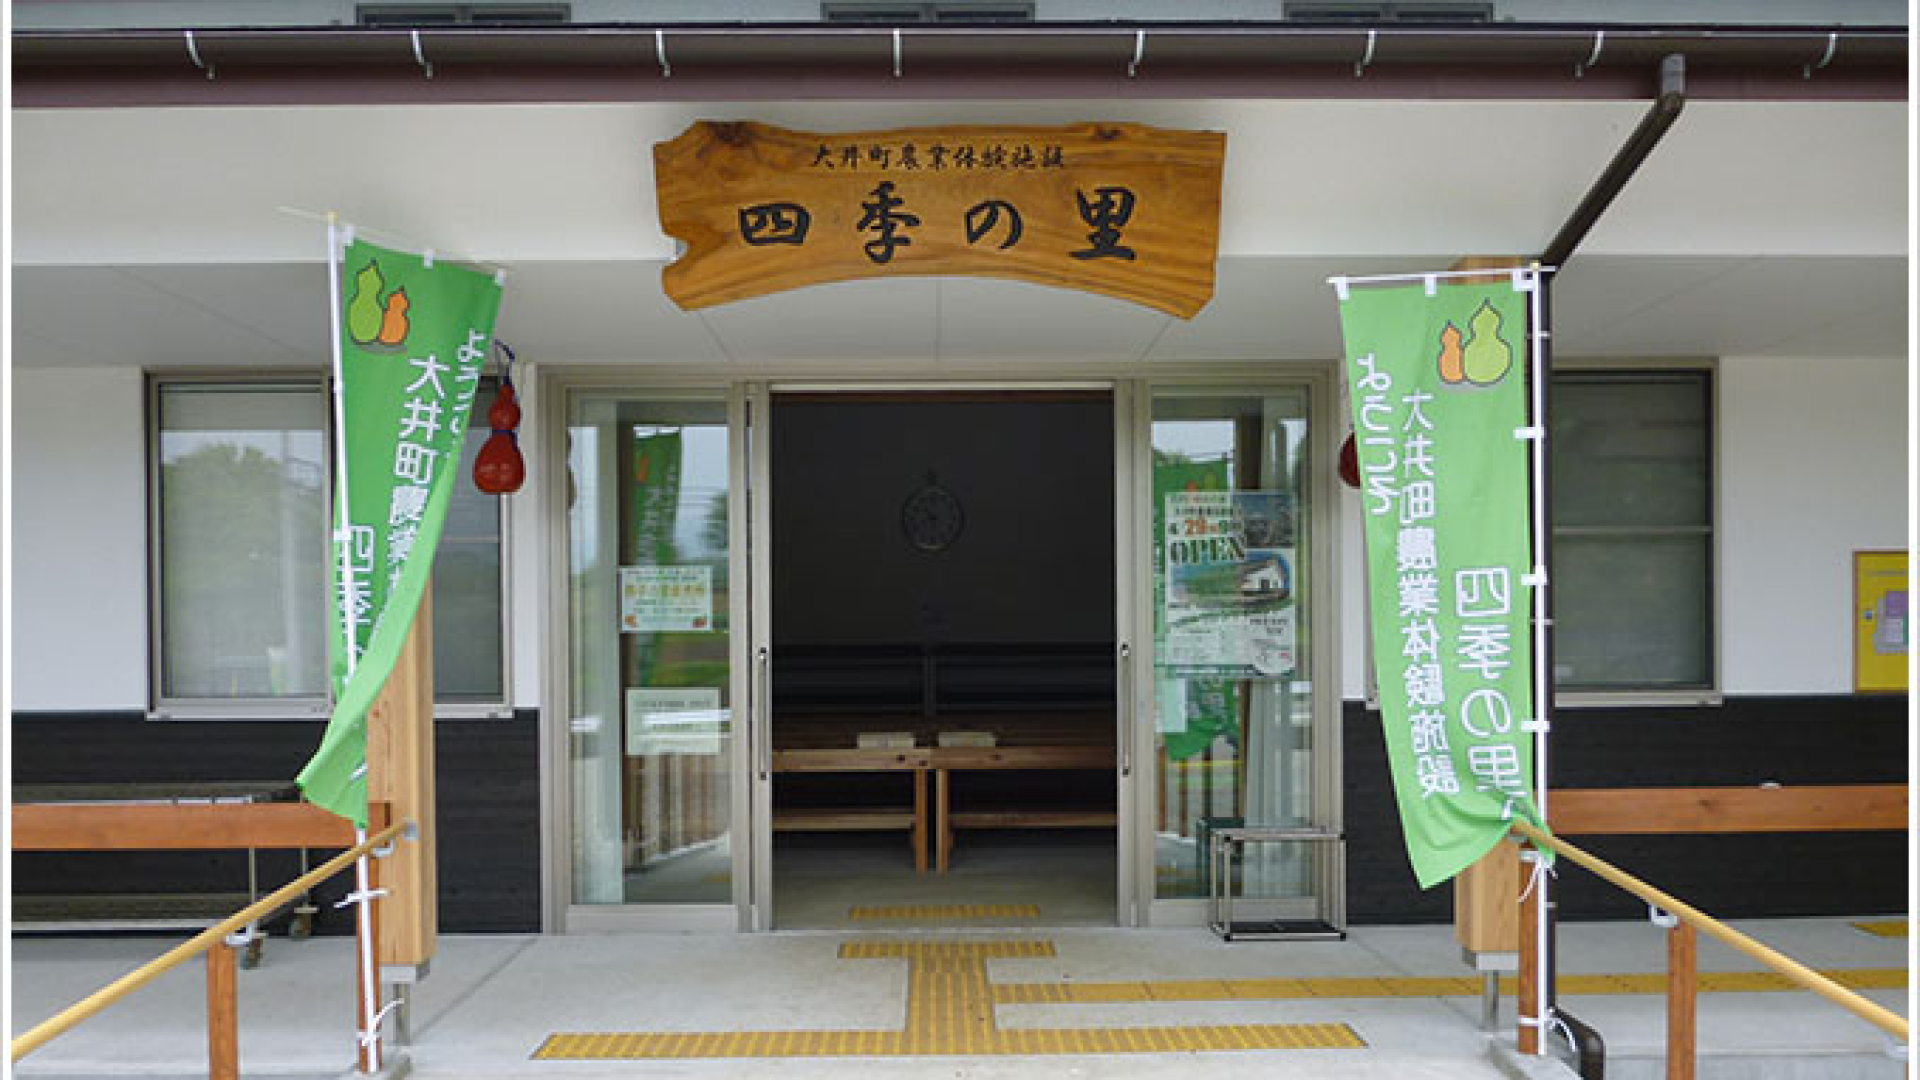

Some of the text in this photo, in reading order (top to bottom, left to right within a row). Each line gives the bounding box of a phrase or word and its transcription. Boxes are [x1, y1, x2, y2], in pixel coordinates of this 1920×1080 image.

[812, 143, 1066, 171] 大井町農業体験施設
[738, 180, 1137, 264] 四季の里
[1169, 536, 1245, 564] OPEN
